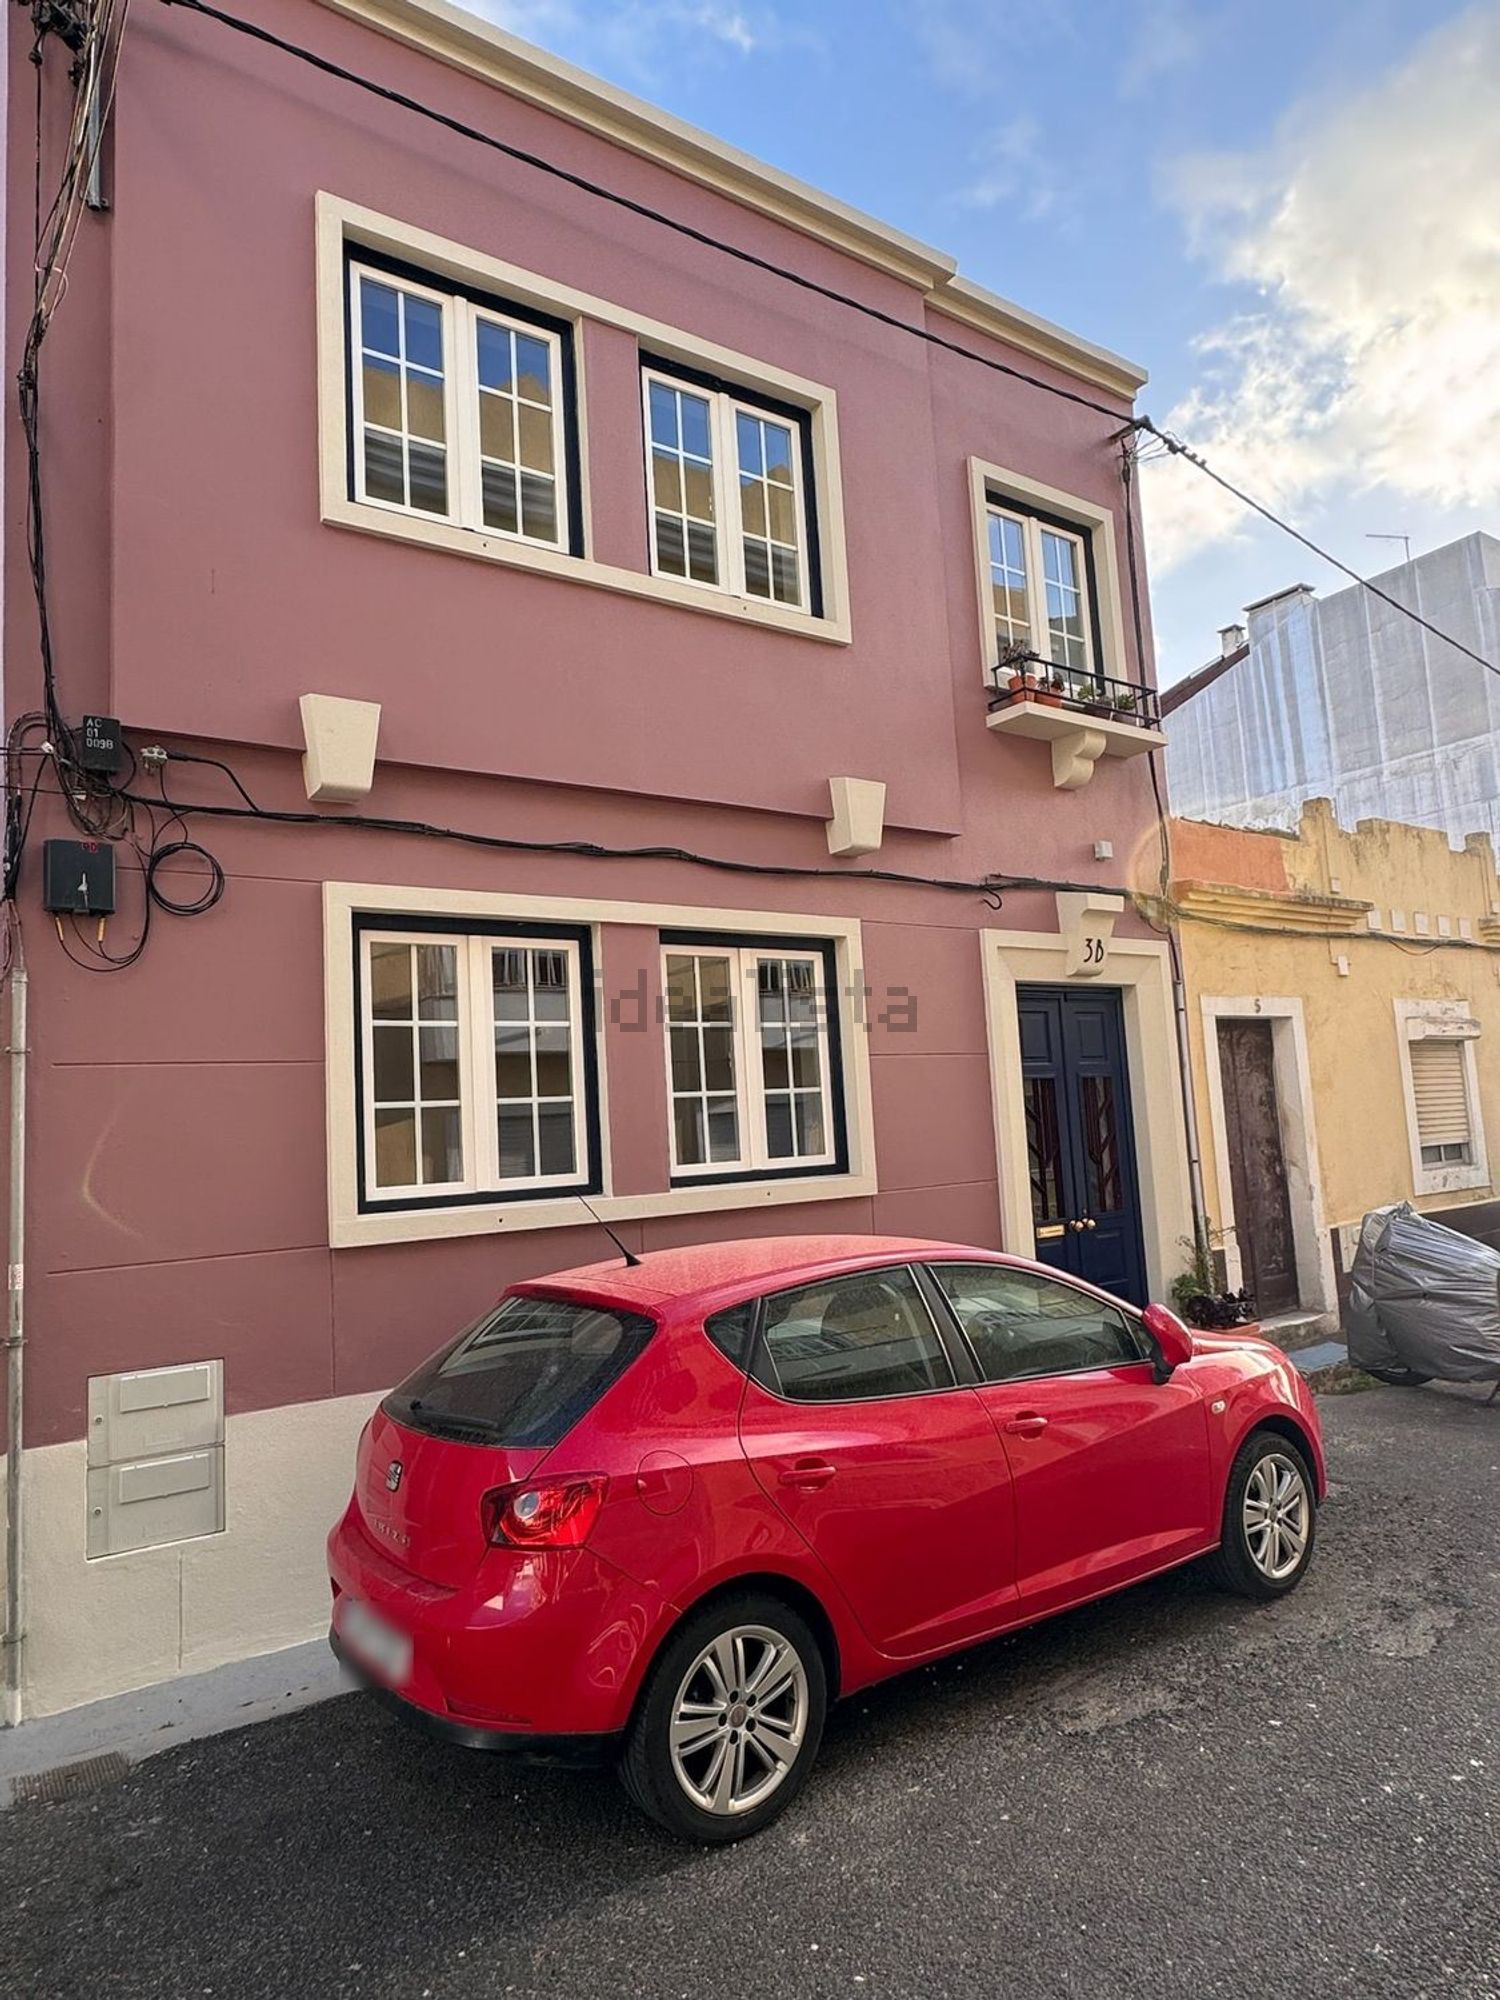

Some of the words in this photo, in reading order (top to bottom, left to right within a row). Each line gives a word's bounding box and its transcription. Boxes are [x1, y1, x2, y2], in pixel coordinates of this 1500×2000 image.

[87, 717, 103, 728] AC
[86, 727, 98, 738] 01
[1083, 938, 1104, 963] 3B
[1254, 998, 1262, 1014] 5
